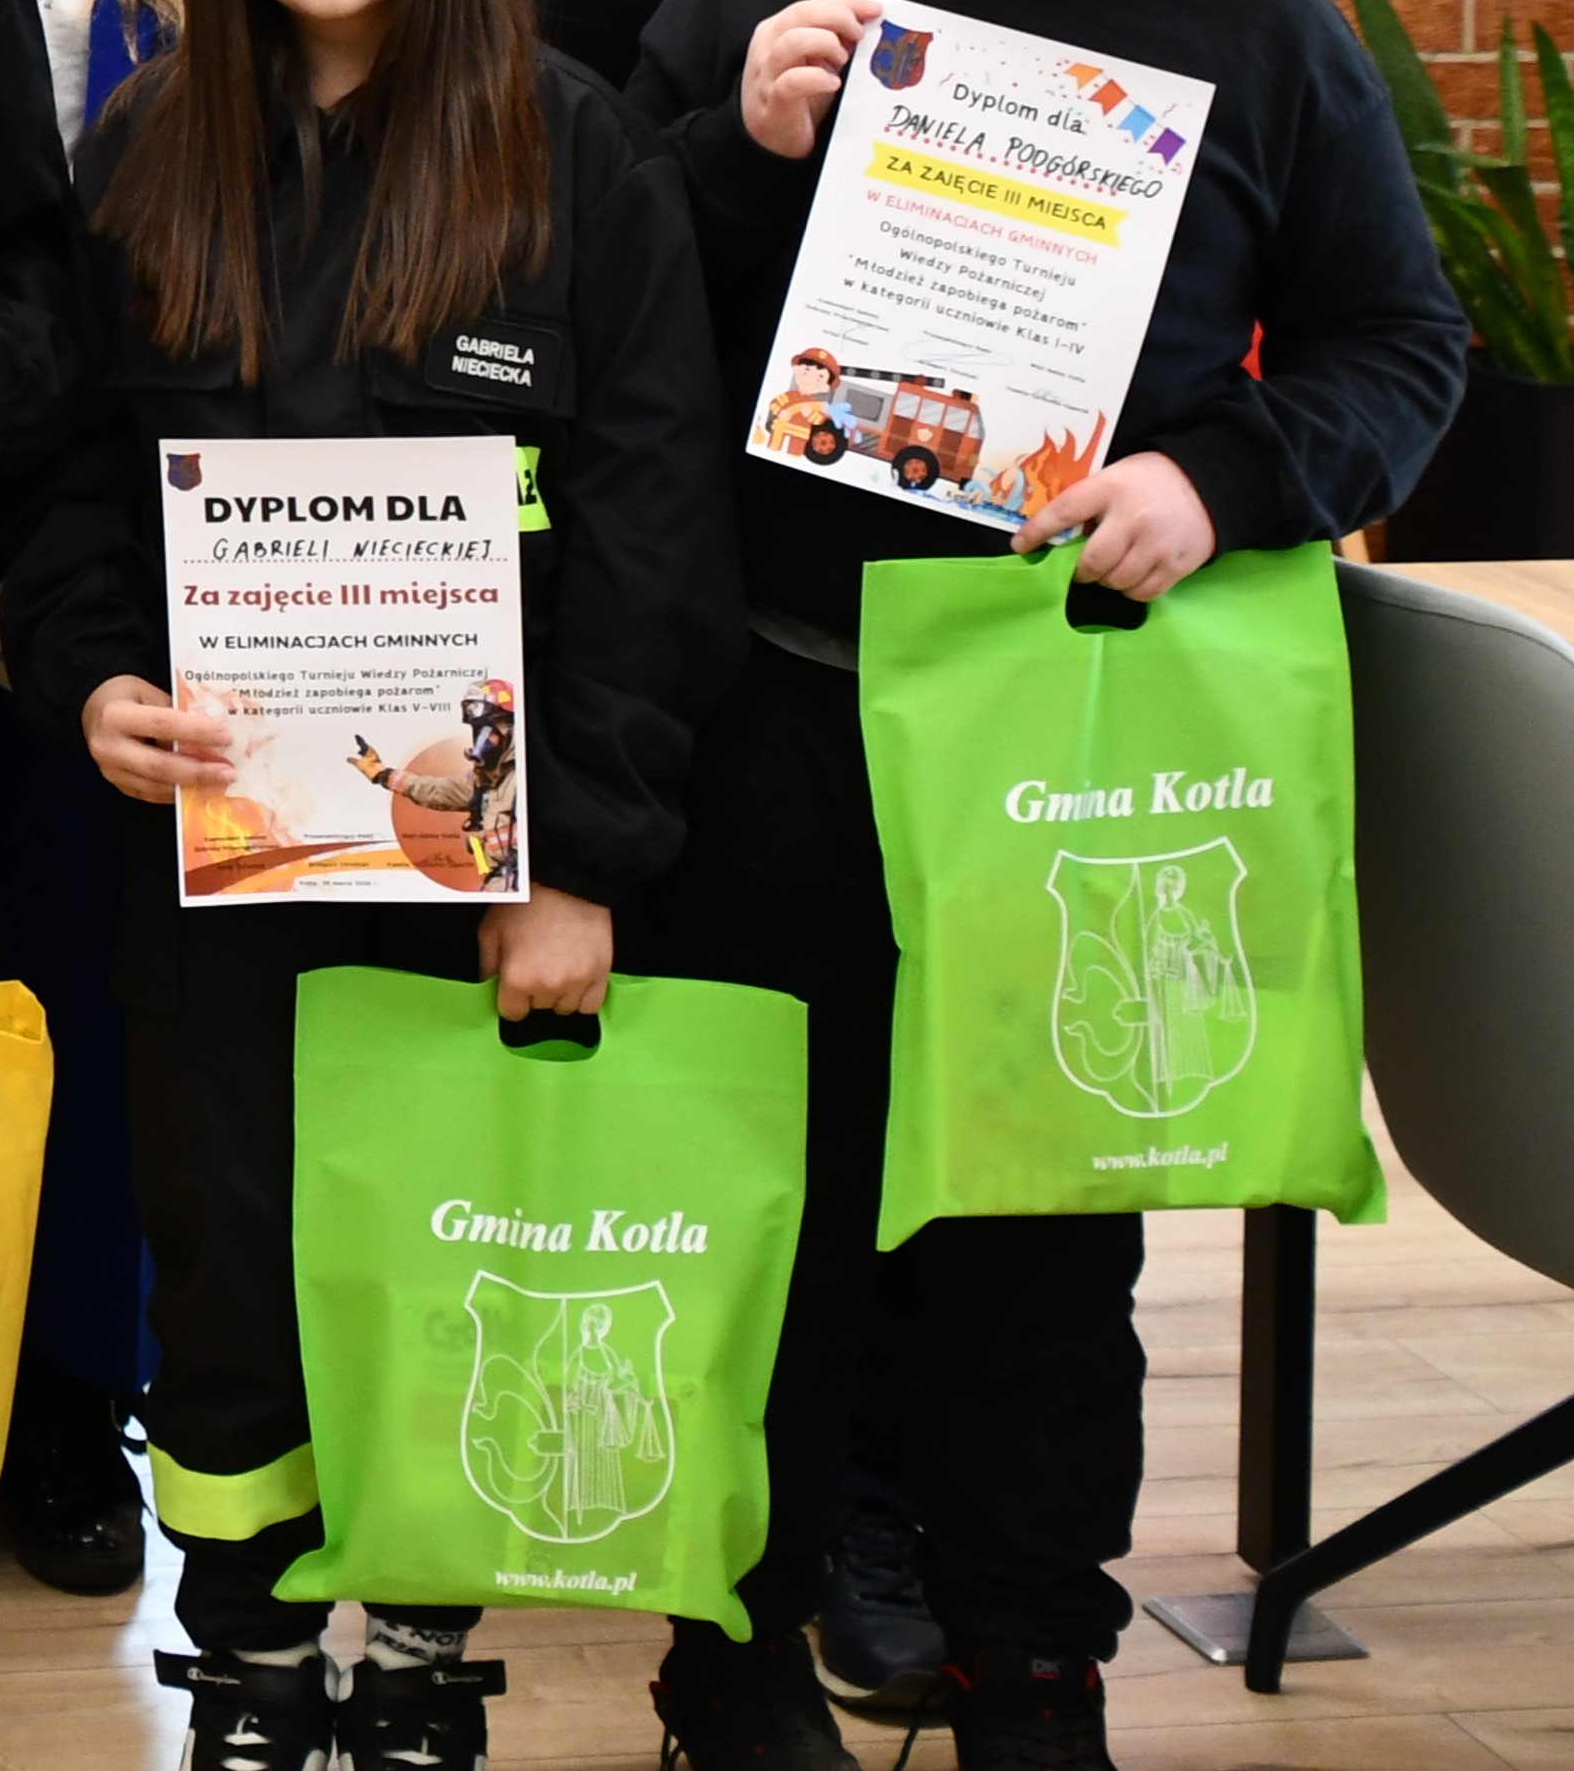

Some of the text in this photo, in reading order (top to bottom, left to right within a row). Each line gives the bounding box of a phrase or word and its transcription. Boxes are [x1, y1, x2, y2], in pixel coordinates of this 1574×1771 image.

[952, 83, 1083, 134] Dyplom dla
[888, 104, 986, 152] DANIELA
[886, 155, 1106, 230] ZA ZAJĘCIE III MIEJSCA
[867, 189, 881, 203] W
[1008, 230, 1098, 265] GMINNYCH
[879, 220, 1076, 287] Ogólnopolskiego Turnieju
[900, 248, 1045, 303] Wiedzy Pożarniczej
[843, 278, 855, 288] w
[860, 281, 930, 310] kategorii
[936, 305, 1009, 333] uczniowie
[1016, 326, 1049, 345] Klas
[929, 281, 1007, 311] zapobiega
[455, 334, 535, 365] GABRIELA
[452, 355, 533, 387] NIECIECKA
[204, 495, 467, 523] DYPLOM DLA
[212, 538, 328, 562] GABRIELI
[183, 581, 498, 613] Za zajęcie III miejsca
[198, 633, 478, 649] W ELIMINACJACH GMINNYCH
[184, 668, 490, 686] Ogólnopolskiego Turnieju Wiedzy Pożarniczej
[305, 687, 372, 699] zapobiega
[227, 707, 238, 716] w
[243, 706, 304, 717] kategorii
[308, 705, 373, 715] uczniowie
[378, 704, 407, 713] Klas
[1004, 767, 1274, 824] Gmina Kotla
[1092, 1141, 1229, 1171] www.kotla.pl
[429, 1198, 709, 1254] Gmina Kotla
[494, 1568, 638, 1596] www.kotla.pl
